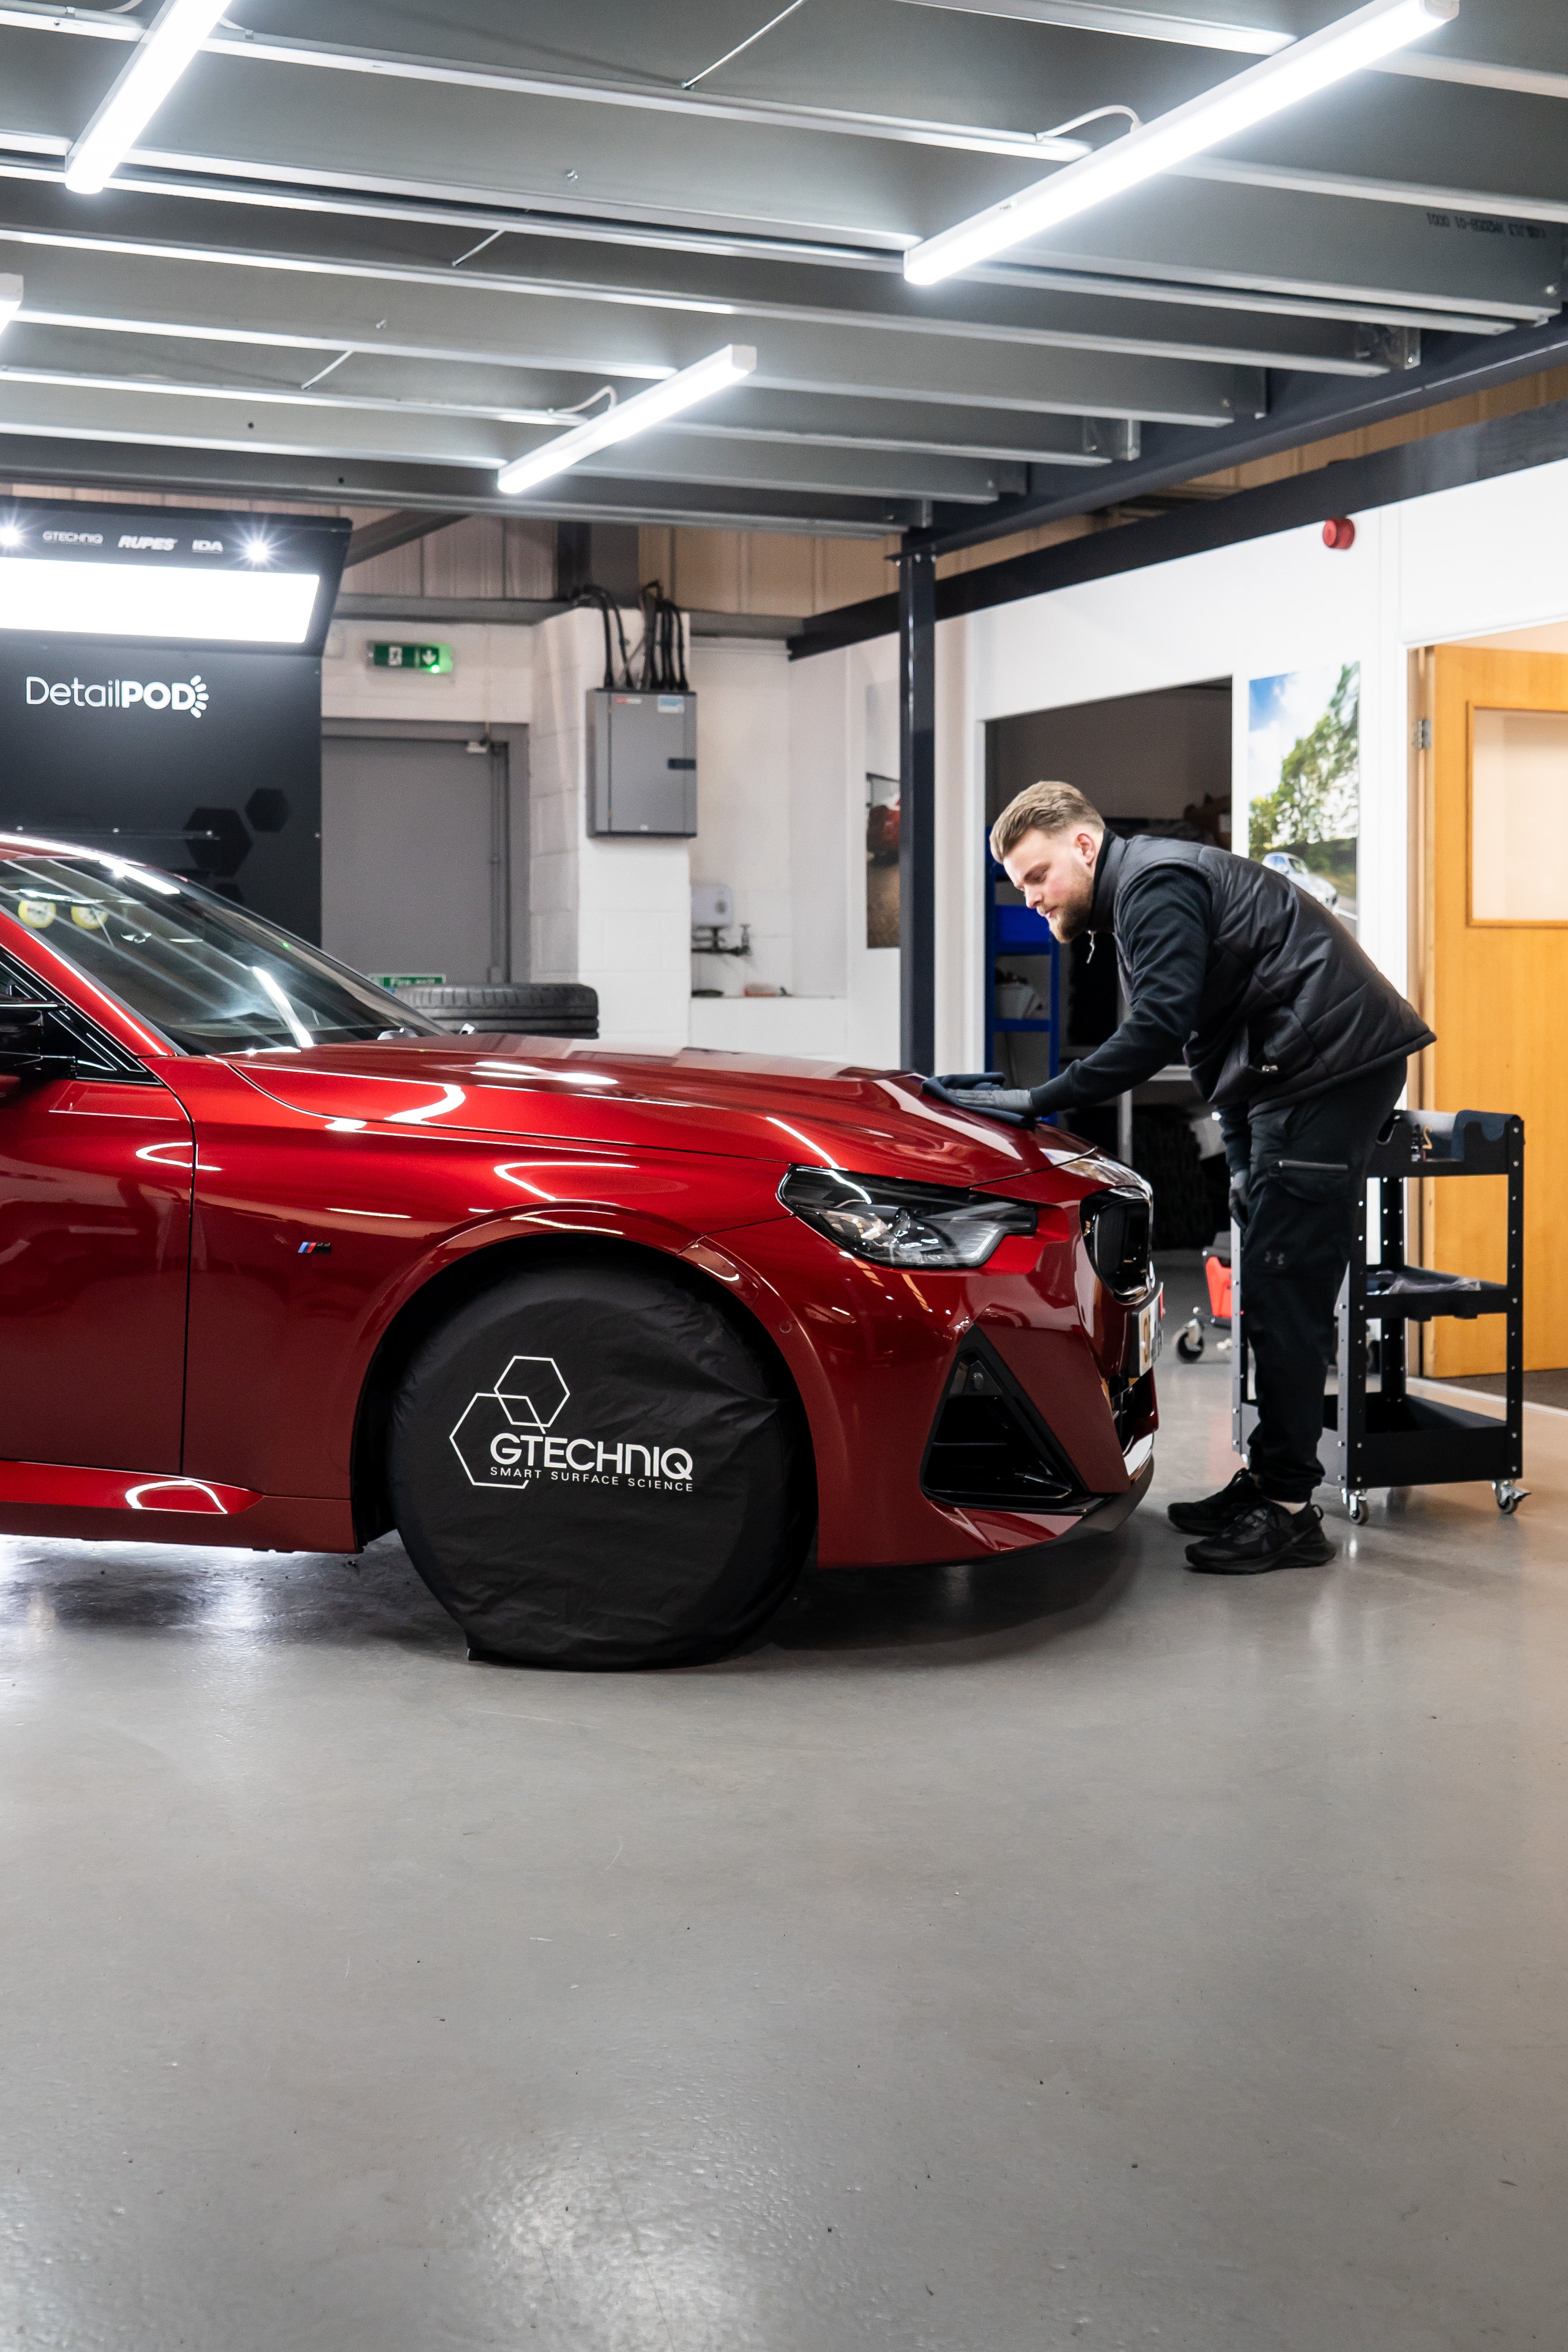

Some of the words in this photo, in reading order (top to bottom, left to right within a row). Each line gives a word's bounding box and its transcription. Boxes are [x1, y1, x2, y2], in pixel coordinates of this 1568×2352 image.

[118, 535, 176, 551] RUPES
[192, 539, 224, 553] IDA
[26, 676, 196, 711] DetailPOD
[490, 1433, 693, 1481] GTECHNIQ
[490, 1466, 542, 1479] SMART
[550, 1471, 619, 1486] SURFACE
[627, 1478, 693, 1492] SCIENCE
